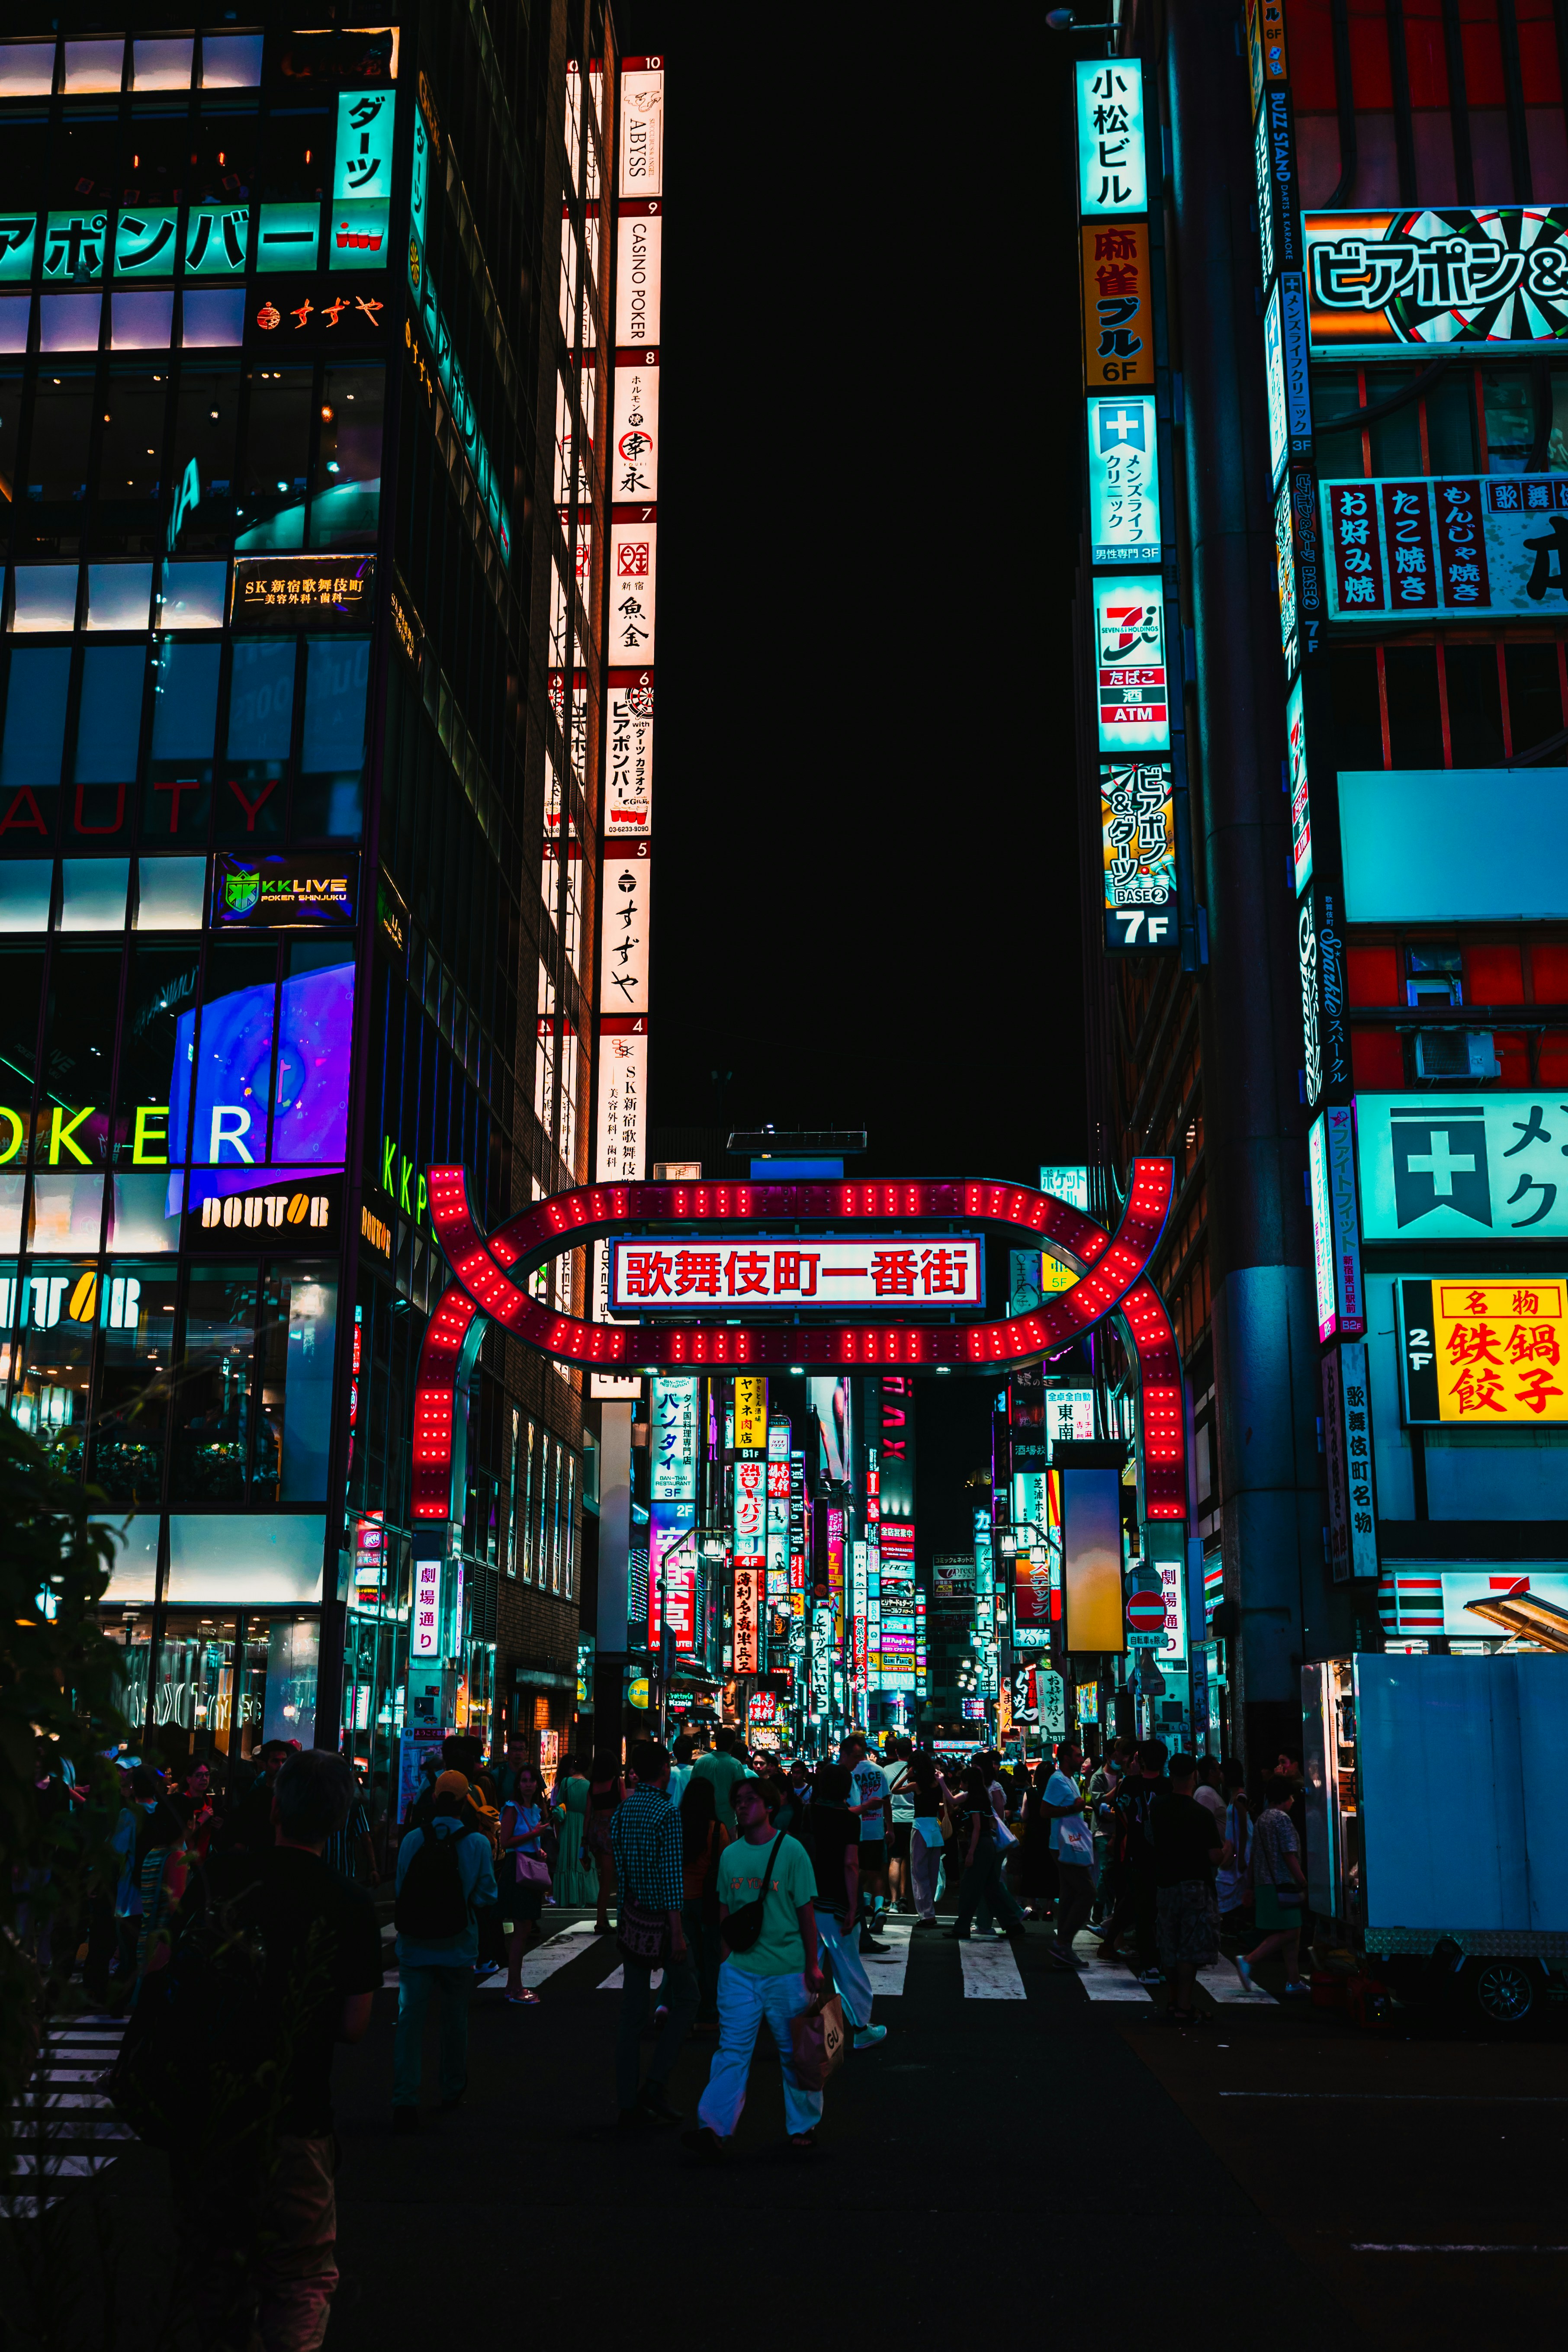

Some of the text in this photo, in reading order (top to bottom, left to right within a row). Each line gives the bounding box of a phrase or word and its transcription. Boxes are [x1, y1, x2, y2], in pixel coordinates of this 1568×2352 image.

[1266, 29, 1282, 39] 6F
[646, 57, 660, 69] 10
[1271, 92, 1288, 129] BUZZ
[347, 96, 386, 190] ダーツ
[629, 119, 646, 177] ABYSS
[1091, 69, 1132, 204] 小松ビル
[1273, 132, 1291, 182] STAND
[649, 202, 658, 214] 9
[1281, 184, 1289, 210] DARTS
[1283, 221, 1293, 260] KARAOKE
[631, 224, 646, 339] CASINO POKER
[1094, 228, 1143, 360] 麻雀ブル
[290, 296, 384, 330] すずや
[646, 352, 655, 364] 8
[1102, 361, 1137, 382] 6F
[1287, 295, 1307, 433] メンズライフクリニック
[1292, 440, 1311, 450] 3F
[1106, 455, 1123, 528] クリニック
[1126, 454, 1143, 542] メンズライフ
[642, 508, 652, 521] 7
[1096, 548, 1159, 559] 男性専門 3F
[1340, 492, 1376, 603] お好み焼
[1392, 490, 1427, 601] たこ焼き
[1443, 487, 1480, 601] もんじゃ焼き
[245, 579, 364, 594] SK 新宿歌舞伎町
[621, 581, 644, 591] 新宿
[617, 596, 649, 648] 魚金
[639, 672, 649, 686] 6
[1110, 670, 1155, 685] たばこ
[1123, 689, 1143, 703] 酒
[1114, 707, 1153, 721] ATM
[635, 757, 646, 795] カラオケ
[1137, 766, 1167, 865] ビアポン
[637, 842, 647, 856] 5
[1298, 829, 1308, 860] ATM
[1116, 910, 1169, 943] 7F
[1325, 896, 1333, 926] 歌舞伎町
[611, 898, 639, 1003] すずや
[1320, 928, 1343, 1017] Sparkle
[633, 1019, 643, 1032] 4
[1327, 1020, 1348, 1084] スパークル
[1042, 1169, 1086, 1190] ポケット
[202, 1193, 329, 1228] DOUTOR
[626, 1249, 969, 1298] 歌舞伎町一番街
[1052, 1278, 1067, 1288] 5F
[1343, 1256, 1356, 1314] 新宿東口駅前
[1463, 1289, 1539, 1315] 名物
[1343, 1320, 1361, 1330] B2F
[1409, 1328, 1433, 1371] 2F
[1445, 1322, 1561, 1367] 鉄鍋
[1047, 1392, 1091, 1401] 全卓全自動
[1448, 1367, 1565, 1414] 餃子
[739, 1378, 753, 1445] ヤマネ肉店
[658, 1393, 680, 1471] バンタイ
[683, 1394, 692, 1465] タイ国料理専門店
[743, 1449, 759, 1458] B1F
[1346, 1386, 1372, 1535] 歌舞伎町名物
[664, 1488, 682, 1497] 3F
[677, 1505, 694, 1517] 2F
[880, 1527, 913, 1538] 全店営業中
[742, 1556, 758, 1566] 4F
[419, 1568, 436, 1648] 劇場通り
[1130, 1635, 1166, 1645] 自転車を除く
[881, 1672, 915, 1685] SAUNA
[826, 2026, 839, 2050] GU
